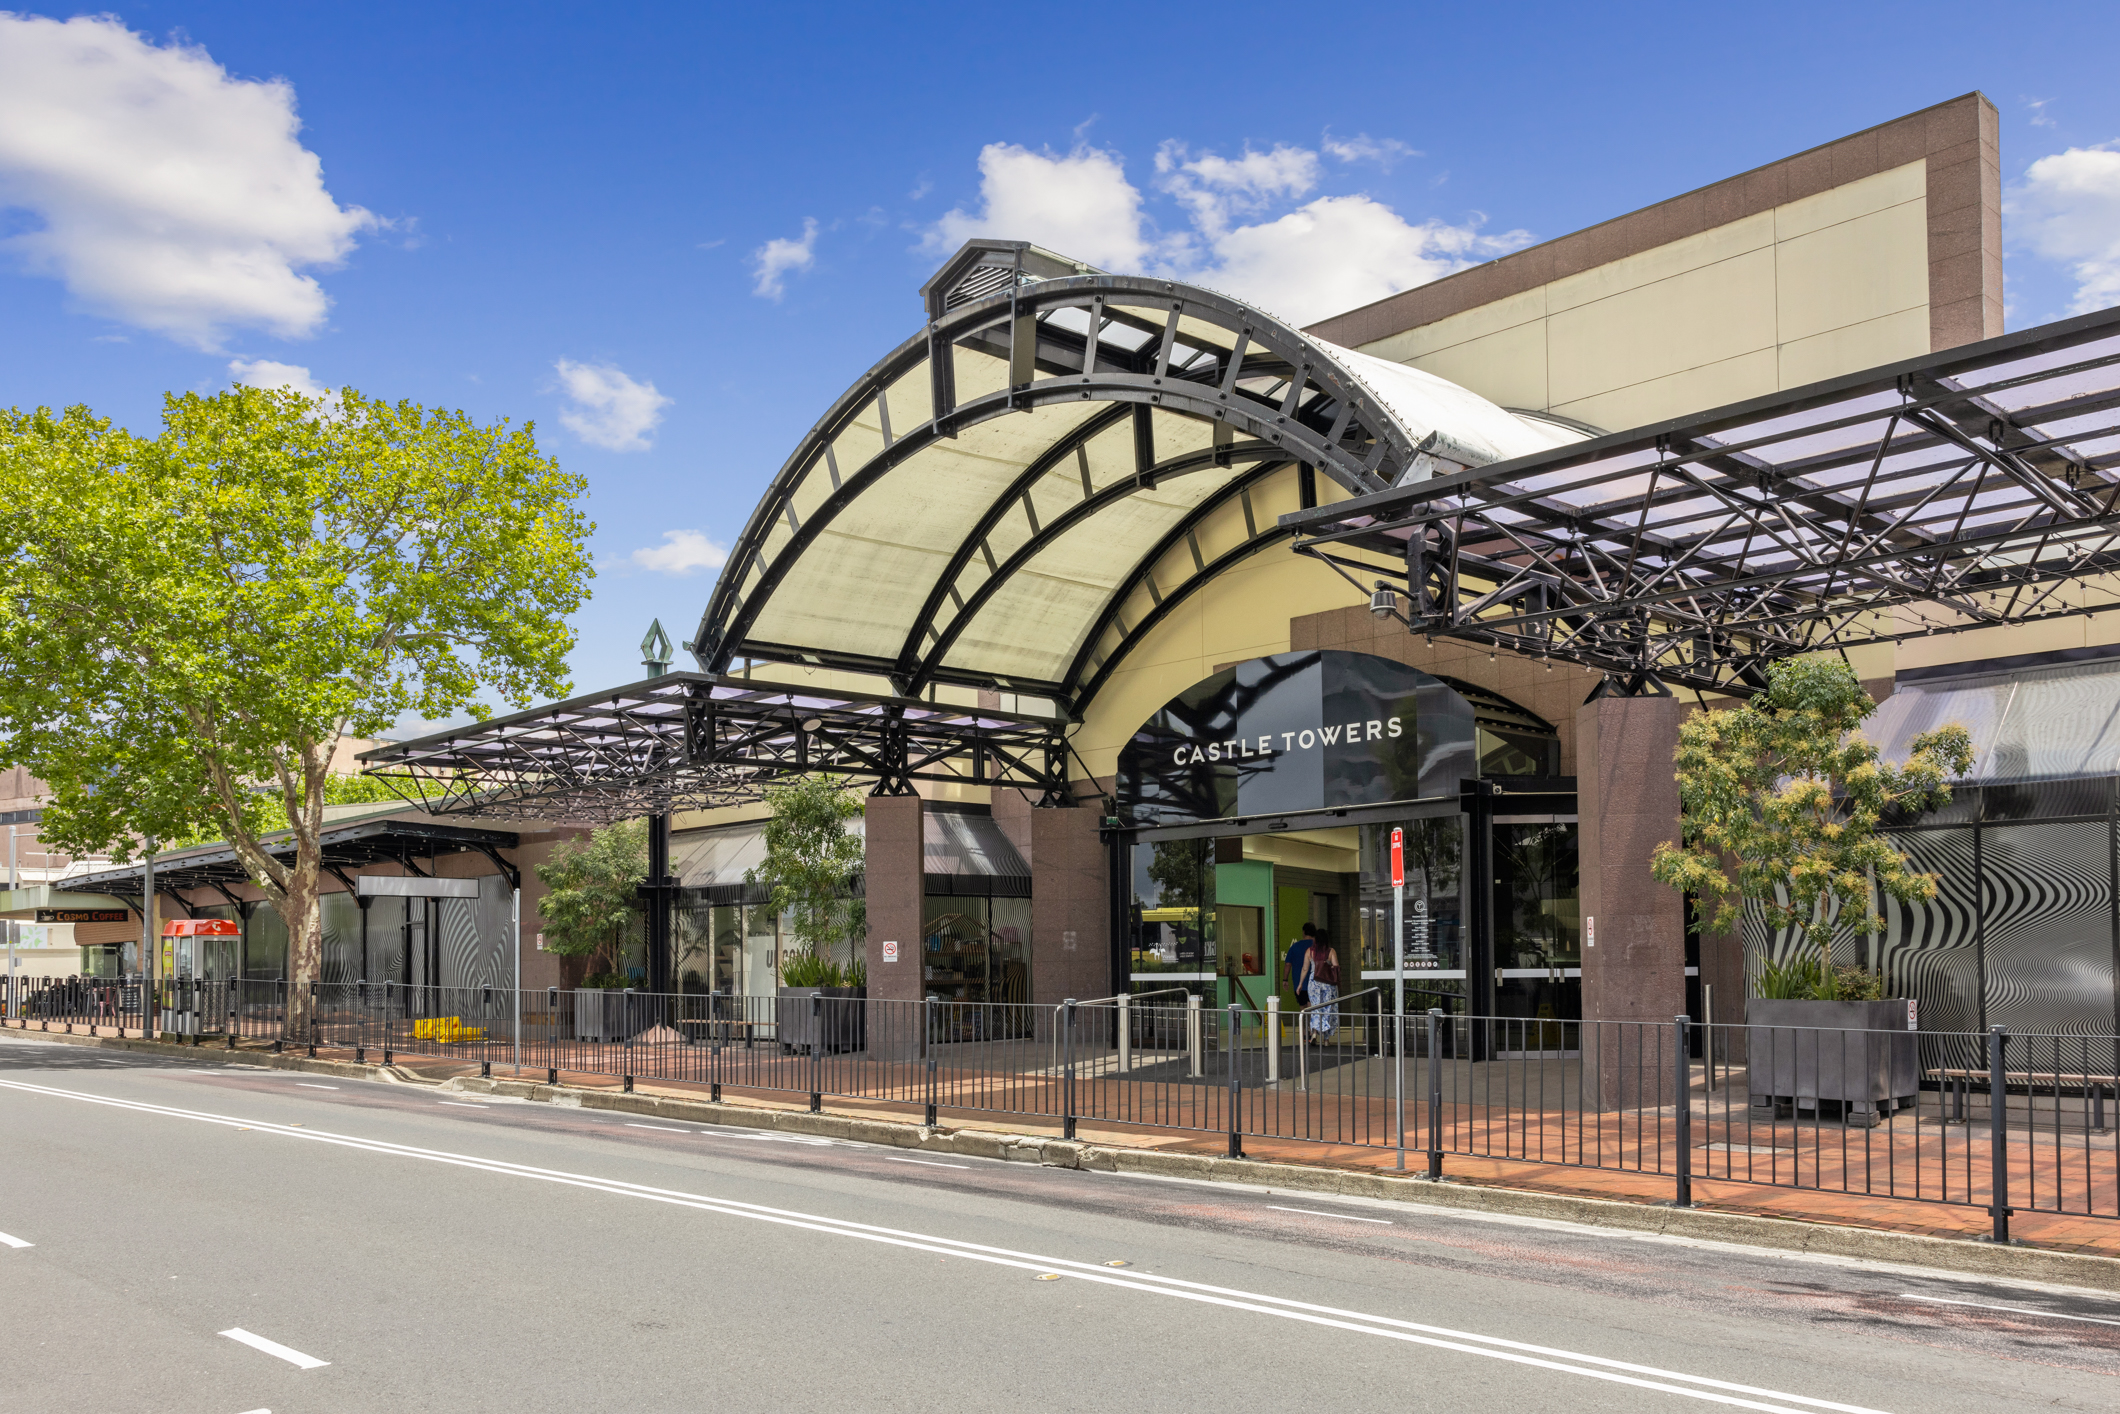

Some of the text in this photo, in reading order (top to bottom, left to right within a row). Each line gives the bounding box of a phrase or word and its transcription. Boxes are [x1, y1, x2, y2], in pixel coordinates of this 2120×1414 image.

[1173, 717, 1403, 766] CASTLE TOWERS
[56, 911, 124, 921] COSMO COFFEE
